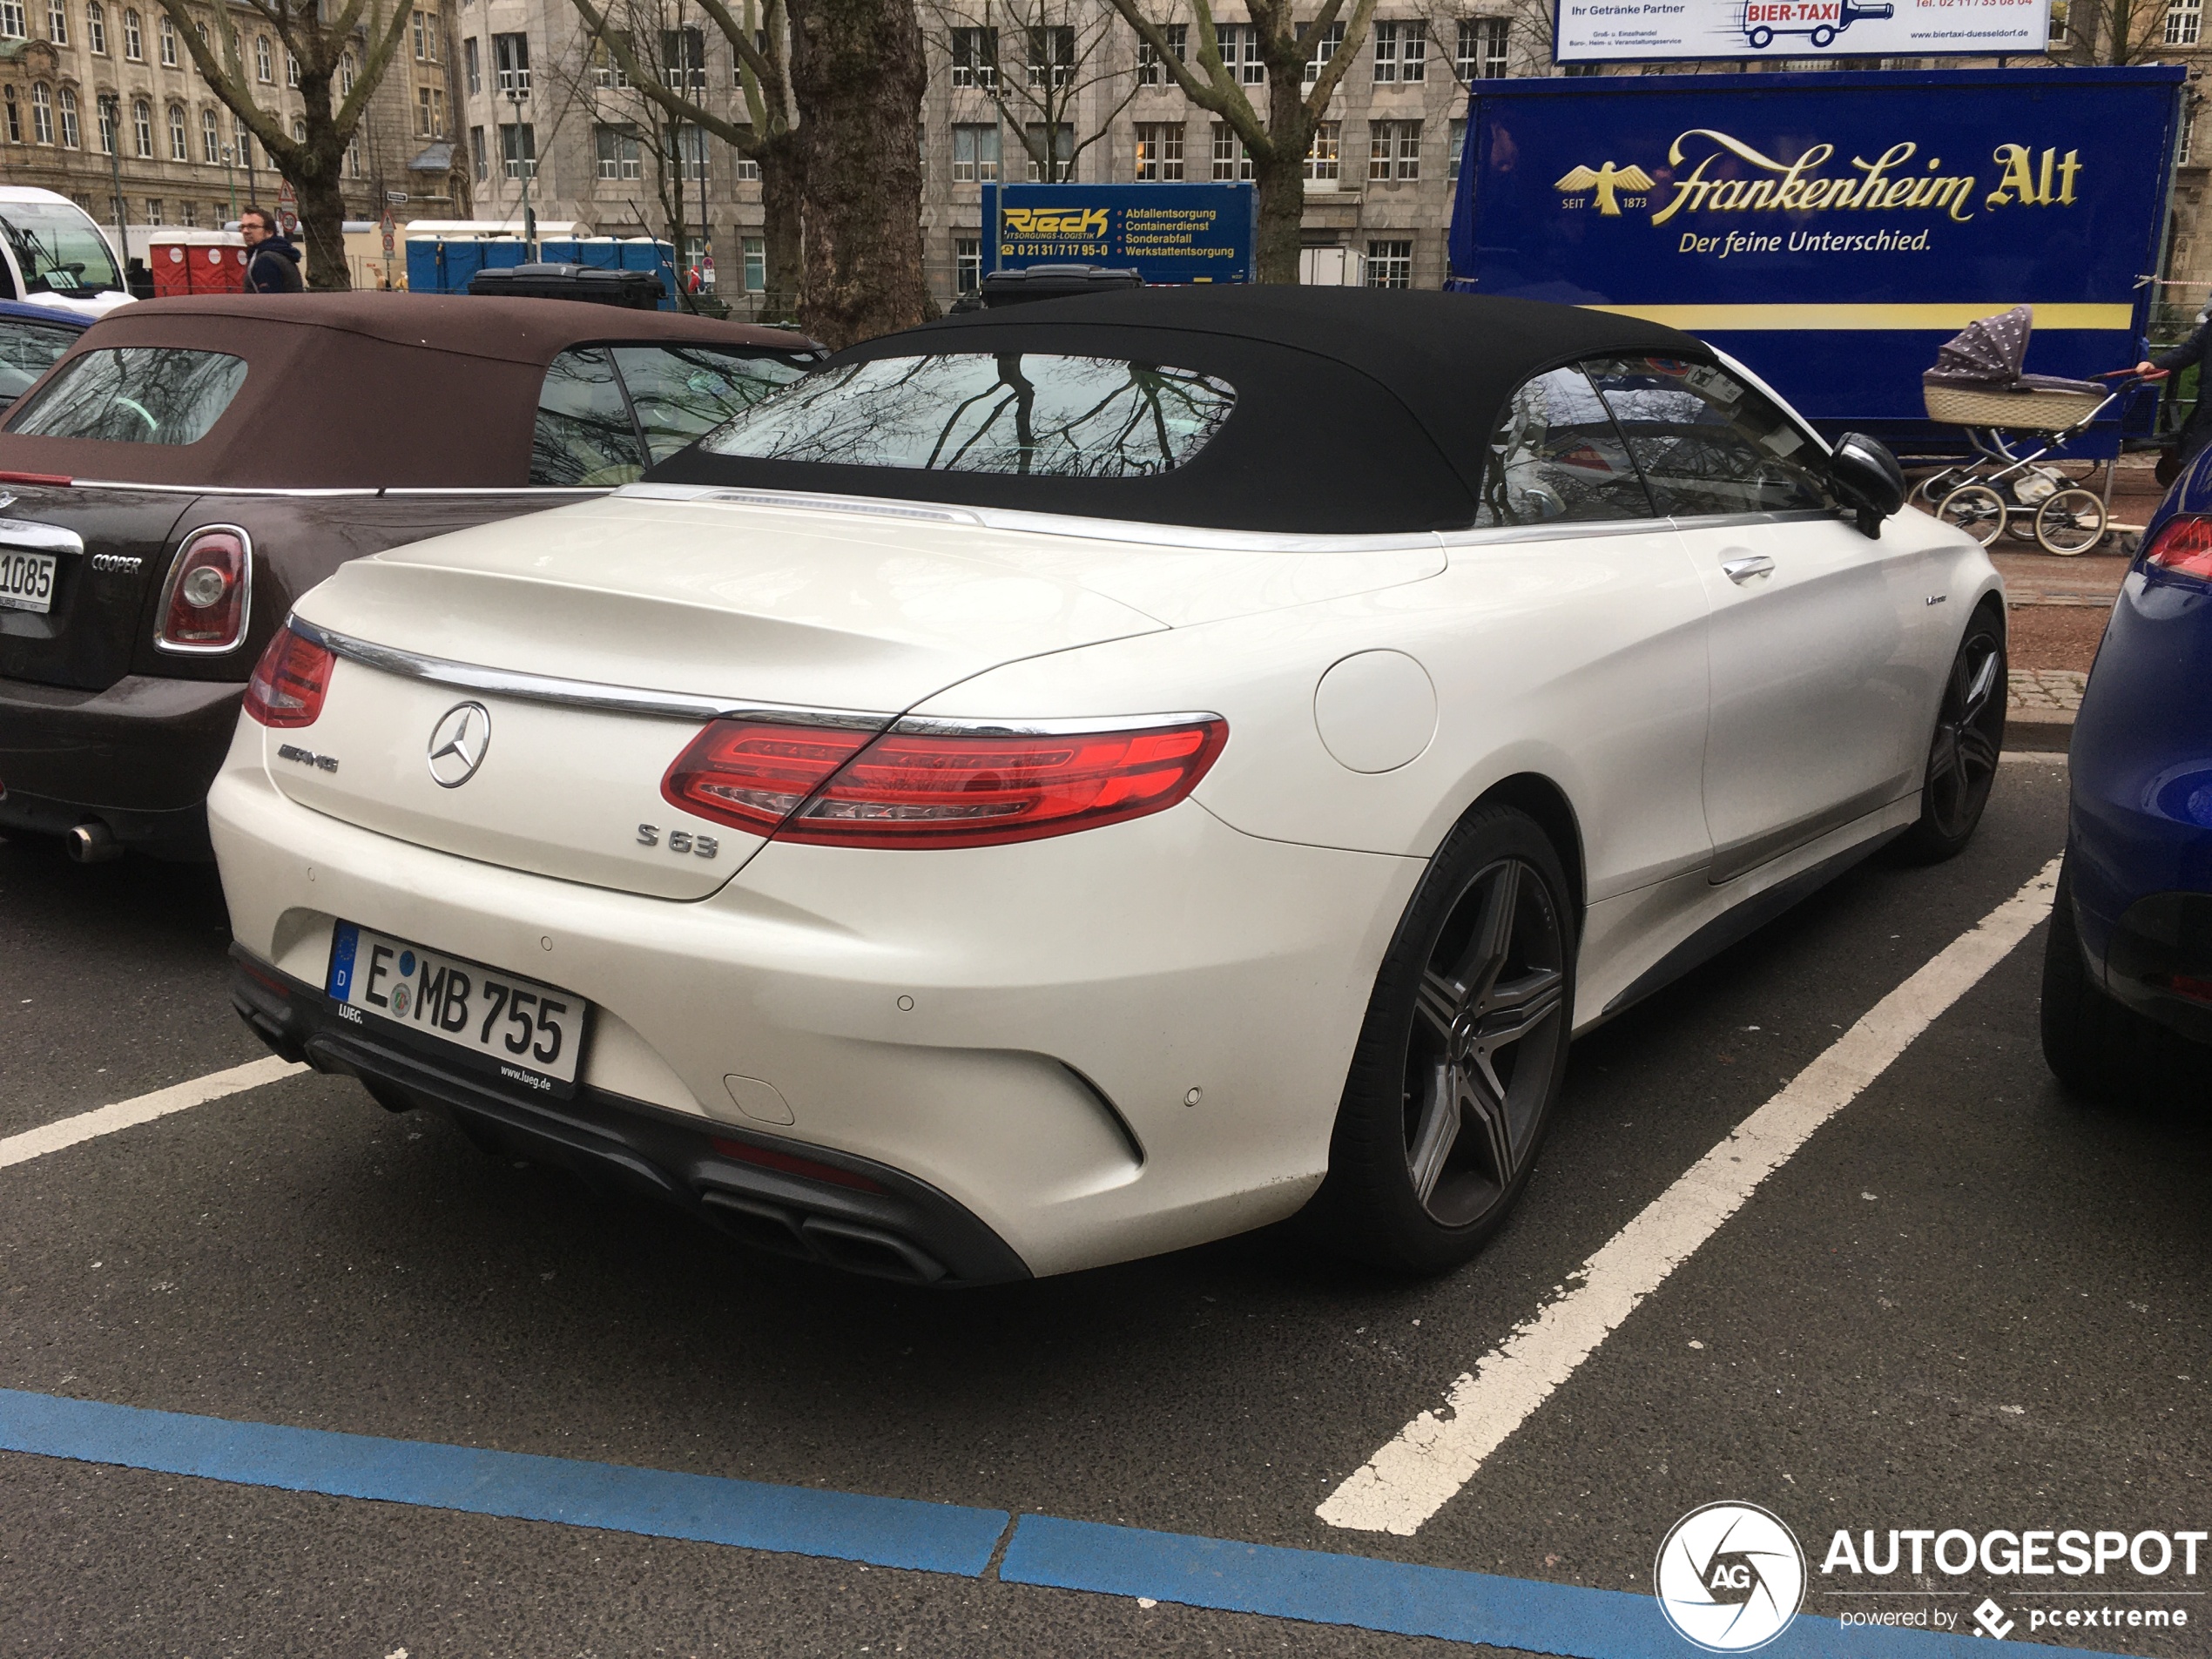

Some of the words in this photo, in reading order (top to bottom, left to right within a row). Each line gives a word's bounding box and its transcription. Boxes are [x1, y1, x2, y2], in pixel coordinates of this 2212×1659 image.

[1572, 6, 1587, 16] Ihr
[1589, 5, 1640, 16] Getränke
[1642, 4, 1685, 14] Partner
[1748, 3, 1840, 22] BIER-TAXI
[1911, 29, 2028, 39] www.biertaxi-duesseldorf.de
[1651, 128, 1975, 226] Frankenheim
[1986, 143, 2083, 212] Alt
[1561, 199, 1585, 209] SEIT
[1623, 198, 1648, 208] 1873
[1125, 209, 1217, 219] Abfallentsorgung
[1125, 221, 1210, 231] Containerdienst
[1125, 233, 1192, 244] Sonderabfall
[1678, 232, 1720, 253] Der
[1718, 230, 1782, 259] feine
[1787, 228, 1931, 252] Unterschied.
[1125, 246, 1235, 258] Werkstattentsorgung
[91, 554, 142, 574] COOPER
[0, 555, 52, 597] 1085
[636, 824, 660, 846] S
[669, 830, 719, 859] 63
[337, 969, 346, 987] D
[338, 1002, 364, 1025] LUEG.
[365, 944, 395, 1008] E
[414, 960, 471, 1033] MB
[480, 980, 567, 1065] 755
[501, 1065, 552, 1091] www.lueg.de
